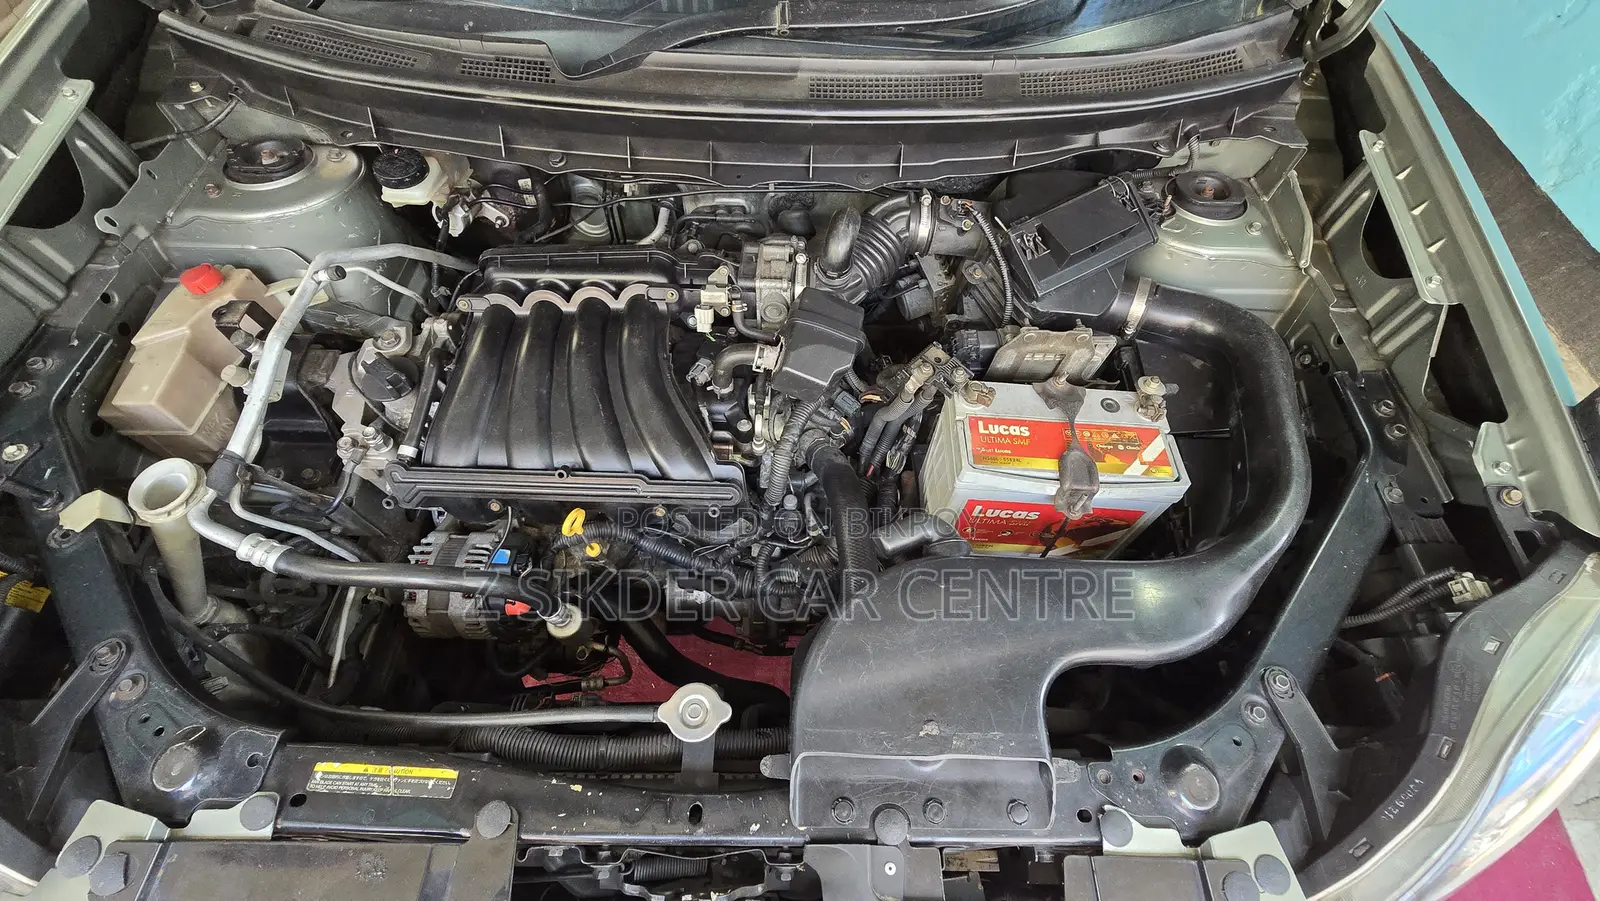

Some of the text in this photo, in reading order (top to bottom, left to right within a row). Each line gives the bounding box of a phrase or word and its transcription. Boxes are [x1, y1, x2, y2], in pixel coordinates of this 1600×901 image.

[978, 420, 1030, 437] Lucas
[980, 436, 1030, 446] ULTIMA SMF
[971, 505, 1040, 520] Lucas
[968, 517, 1007, 526] ULTIMA
